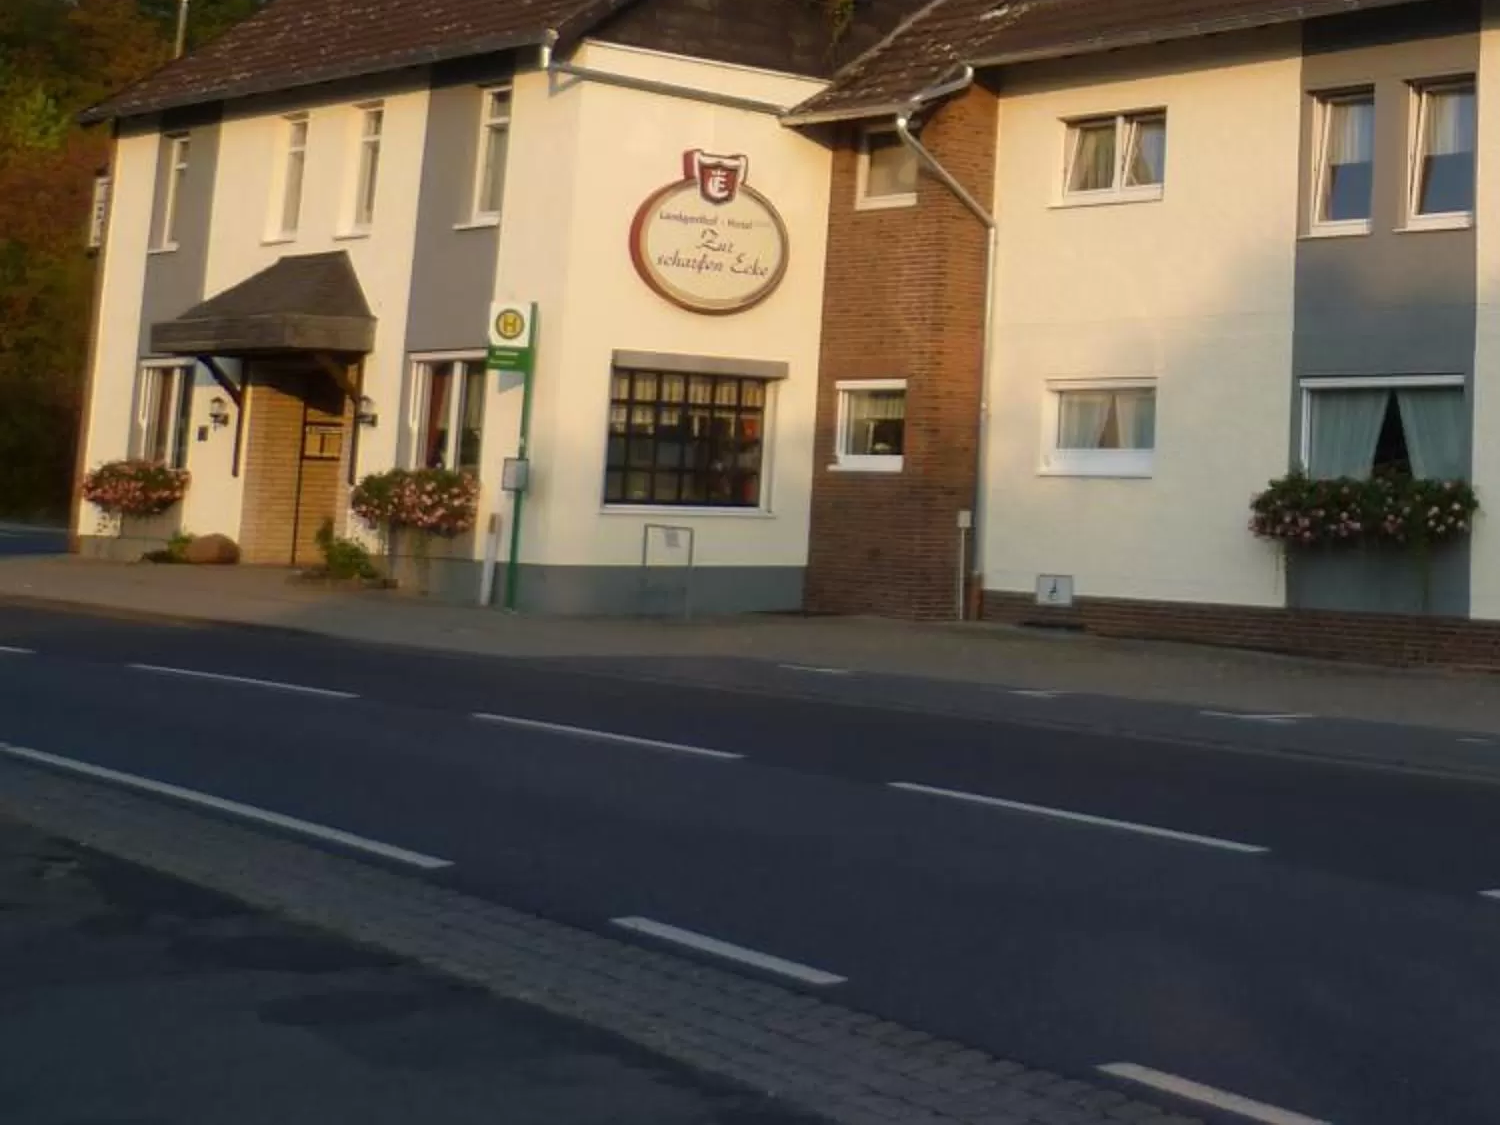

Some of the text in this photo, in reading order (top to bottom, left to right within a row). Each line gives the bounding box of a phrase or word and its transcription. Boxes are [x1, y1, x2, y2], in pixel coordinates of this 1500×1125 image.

[727, 218, 753, 230] Hotel
[695, 227, 734, 253] Zur
[656, 249, 769, 276] scharfen Ecke
[503, 315, 517, 332] H
